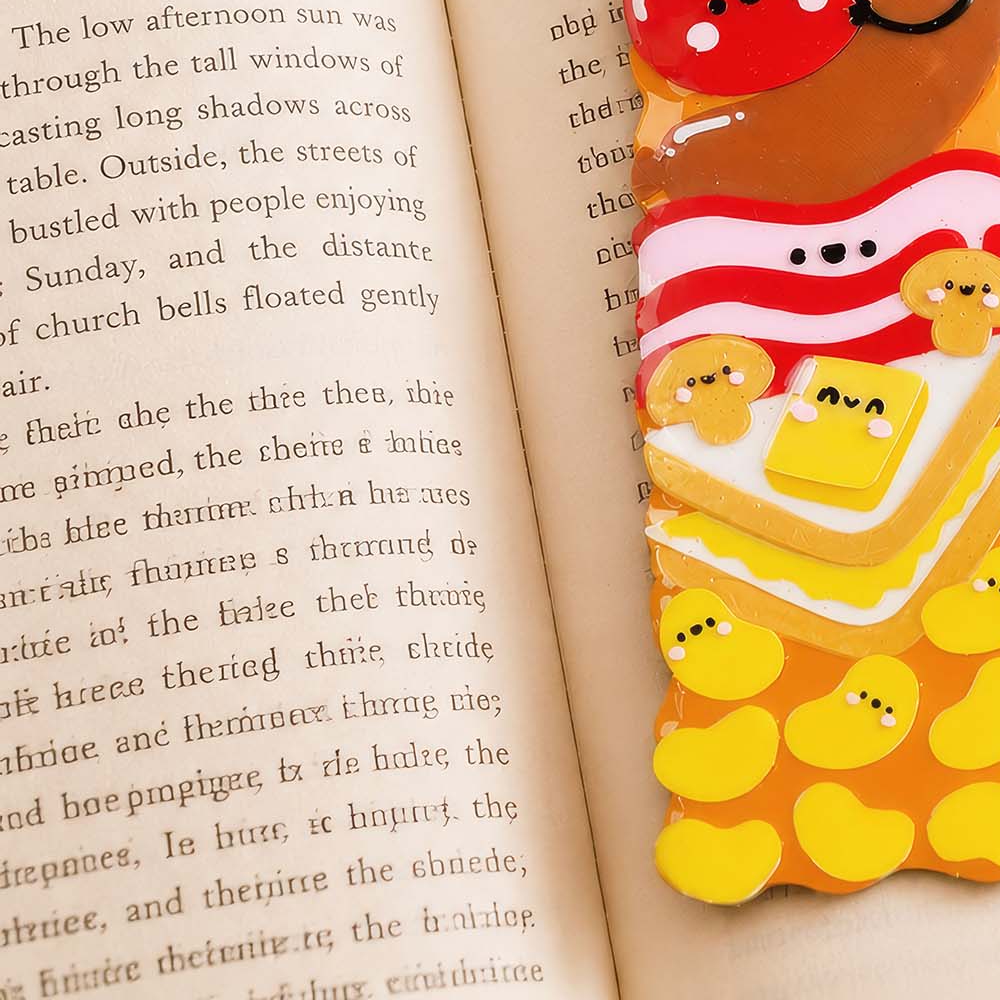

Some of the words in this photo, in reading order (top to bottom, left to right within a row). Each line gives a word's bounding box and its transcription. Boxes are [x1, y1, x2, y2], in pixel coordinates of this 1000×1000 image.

[11, 21, 71, 50] The
[80, 15, 135, 40] low
[146, 5, 287, 32] afternoon
[296, 7, 343, 25] sun
[351, 12, 397, 33] was
[0, 59, 123, 100] through
[132, 53, 180, 80] the
[190, 46, 238, 74] tall
[248, 45, 370, 73] windows
[380, 54, 404, 78] of
[114, 104, 184, 131] long
[197, 91, 320, 120] shadows
[334, 99, 412, 123] across
[6, 162, 88, 195] table.
[99, 143, 227, 180] Outside,
[238, 138, 285, 165] the
[296, 143, 383, 165] streets
[393, 144, 418, 169] of
[8, 202, 121, 244] bustled
[130, 193, 200, 225] with
[209, 184, 306, 224] people
[315, 185, 427, 222] enjoying
[25, 254, 146, 292] Sunday,
[169, 238, 226, 270] and
[247, 234, 298, 261] the
[0, 318, 21, 348] of
[35, 301, 141, 341] church
[156, 289, 227, 321] bells
[242, 279, 345, 311] floated
[360, 283, 440, 316] gently
[1, 370, 50, 398] air.
[184, 392, 234, 420] the
[193, 442, 243, 471] the
[146, 608, 199, 638] the
[0, 802, 46, 833] nd
[464, 737, 510, 766] the
[125, 885, 185, 923] and
[346, 856, 394, 887] the
[351, 911, 402, 943] the
